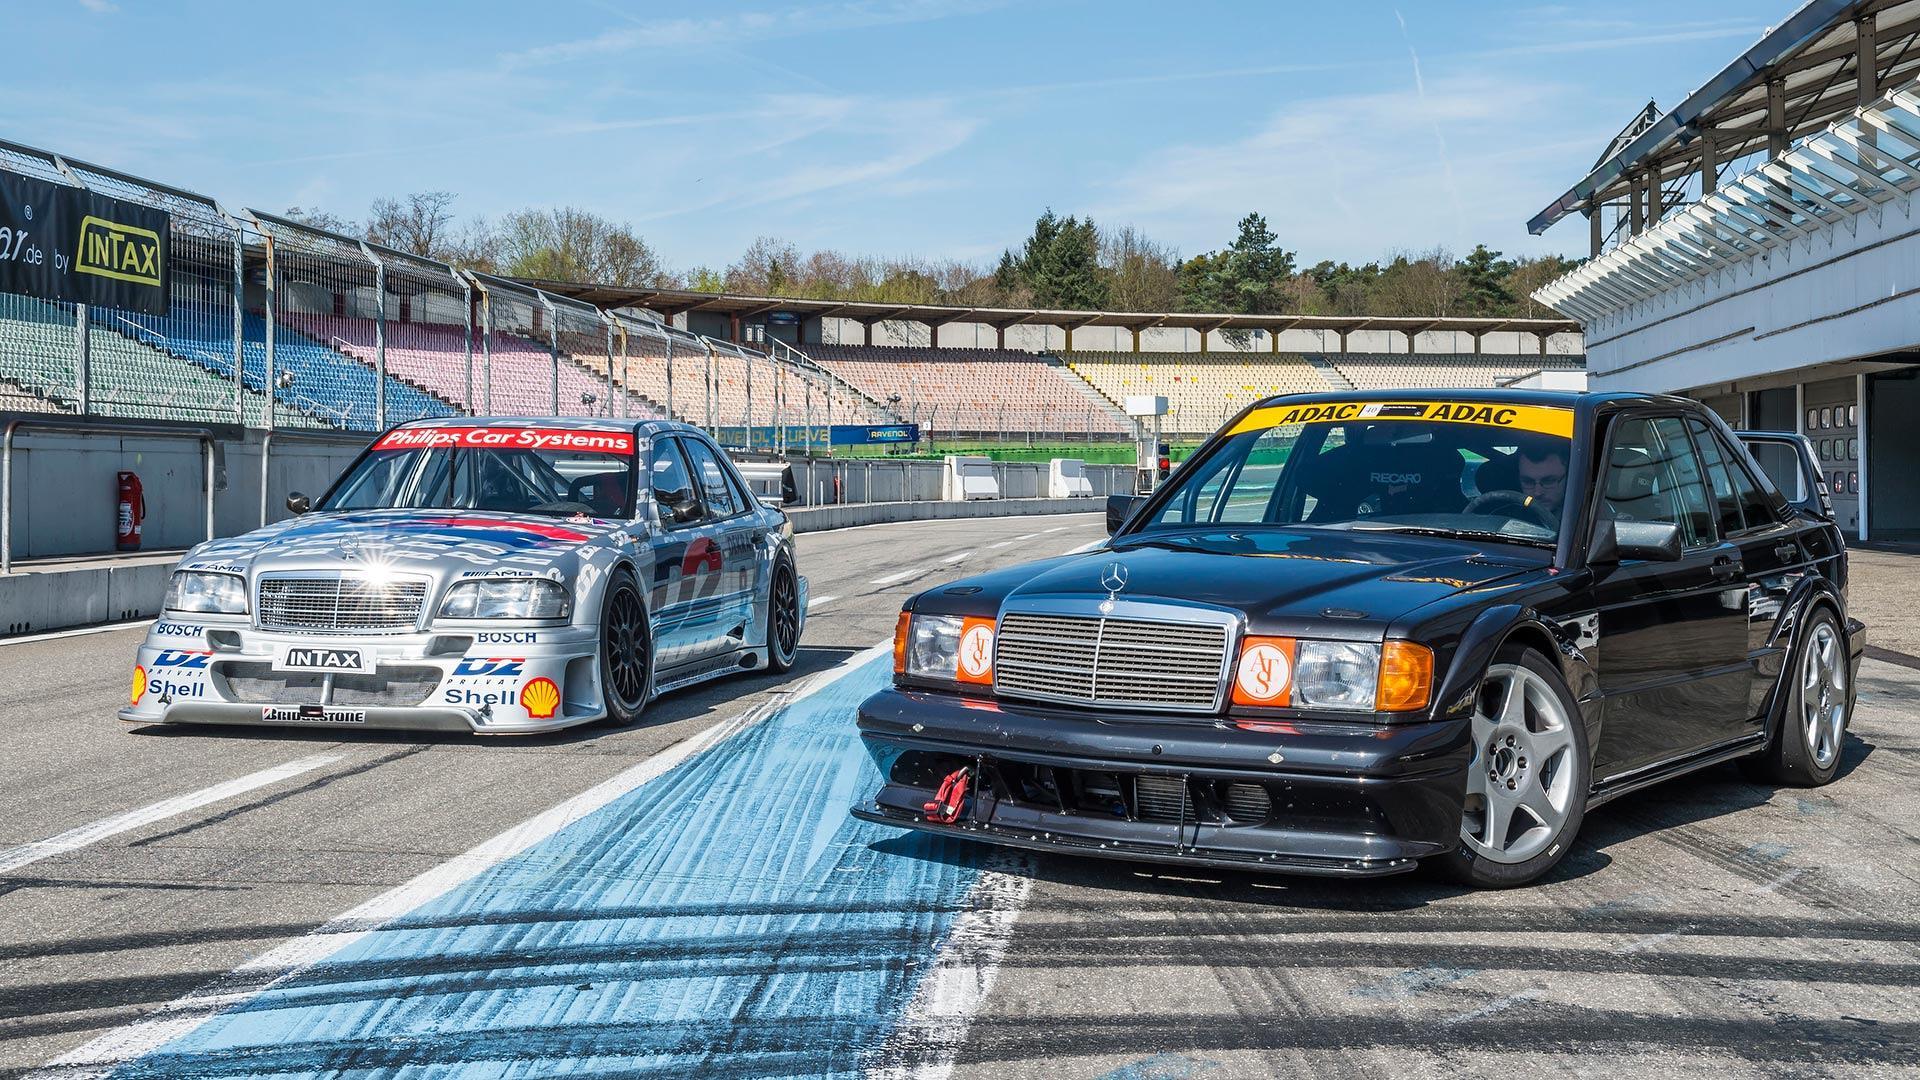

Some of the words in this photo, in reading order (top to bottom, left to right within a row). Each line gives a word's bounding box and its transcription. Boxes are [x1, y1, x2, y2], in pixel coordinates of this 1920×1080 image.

[55, 249, 70, 275] by
[88, 232, 156, 276] INTAX
[1278, 404, 1358, 425] ADAC
[1429, 404, 1517, 425] ADAC
[382, 429, 461, 447] Philips
[466, 429, 516, 444] Car
[516, 430, 628, 449] Systems
[871, 430, 908, 439] RAVENOL
[1370, 472, 1422, 484] RECARO
[205, 564, 245, 572] AMG
[158, 623, 203, 637] BOSCH
[478, 632, 537, 643] BOSCH
[290, 649, 359, 668] INTAX
[148, 668, 203, 677] PRIVAT
[148, 679, 204, 697] Shell
[445, 689, 515, 705] Shell
[264, 708, 364, 722] BRIDSTONE
